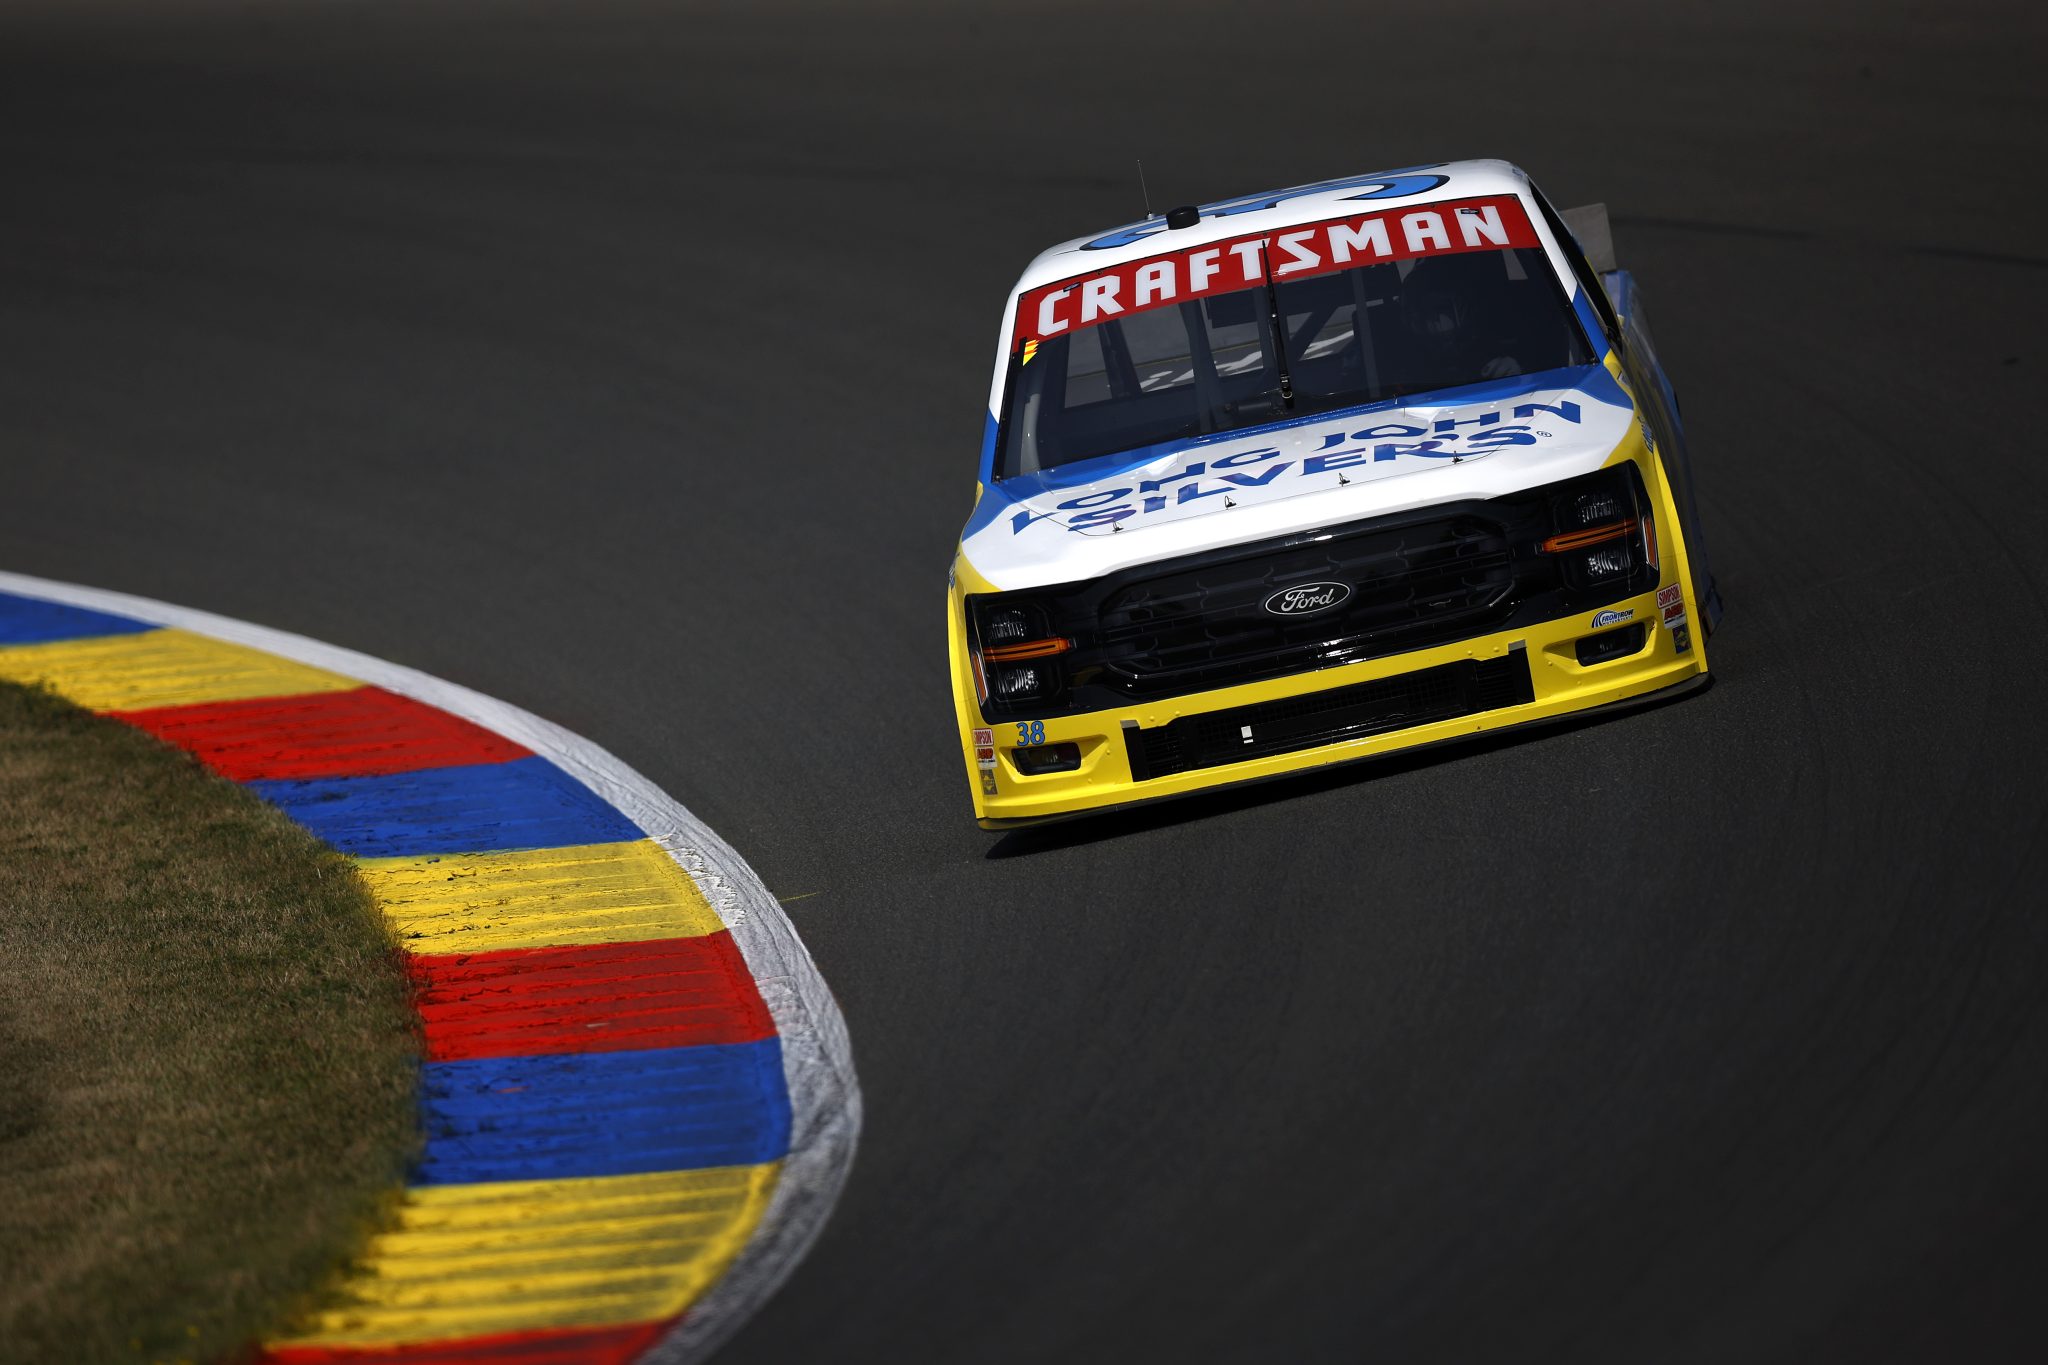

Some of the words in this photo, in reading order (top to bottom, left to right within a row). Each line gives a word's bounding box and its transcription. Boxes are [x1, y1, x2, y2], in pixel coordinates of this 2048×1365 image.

[1036, 205, 1510, 337] CRAFTSMAN
[1010, 447, 1281, 536] LONG
[1312, 400, 1581, 452] JOHN
[1280, 586, 1335, 612] Ford
[1016, 720, 1045, 747] 38
